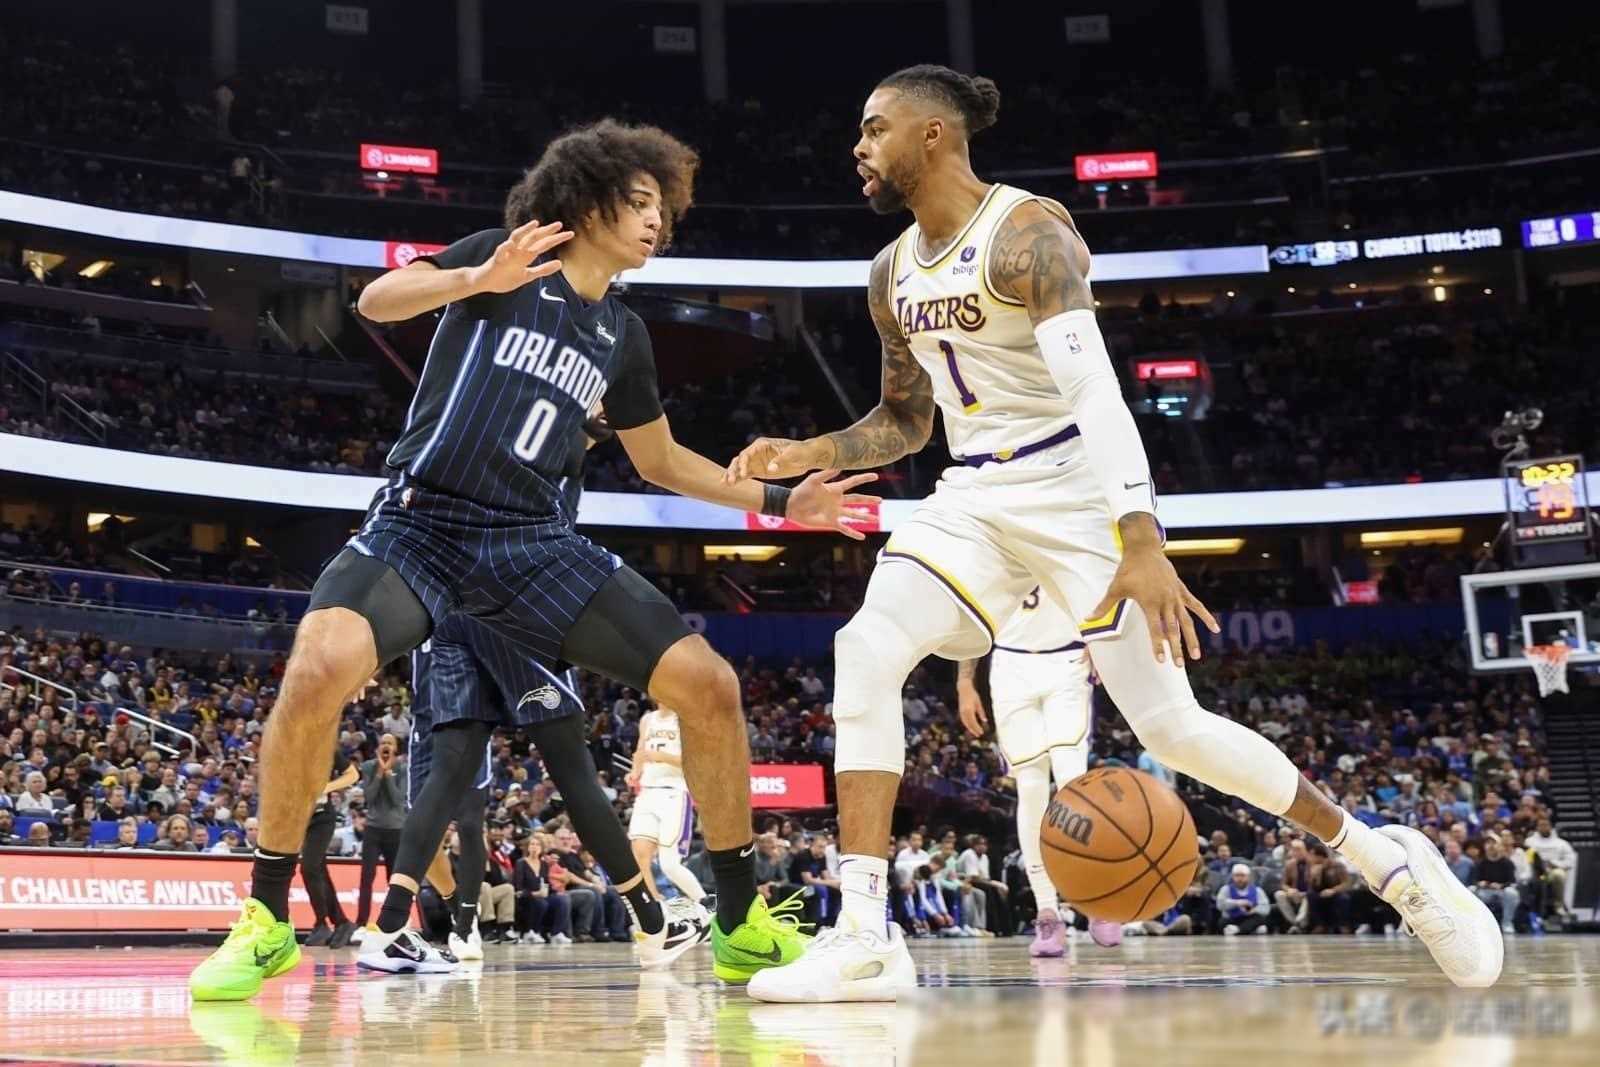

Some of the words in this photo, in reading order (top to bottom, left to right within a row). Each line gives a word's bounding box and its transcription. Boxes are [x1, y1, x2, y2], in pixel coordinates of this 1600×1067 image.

[1364, 235, 1423, 258] CURRENT
[1560, 218, 1577, 241] 0
[493, 325, 608, 419] ORLANDO
[939, 339, 980, 411] 1
[513, 398, 558, 461] 0
[11, 876, 148, 904] CHALLENGE
